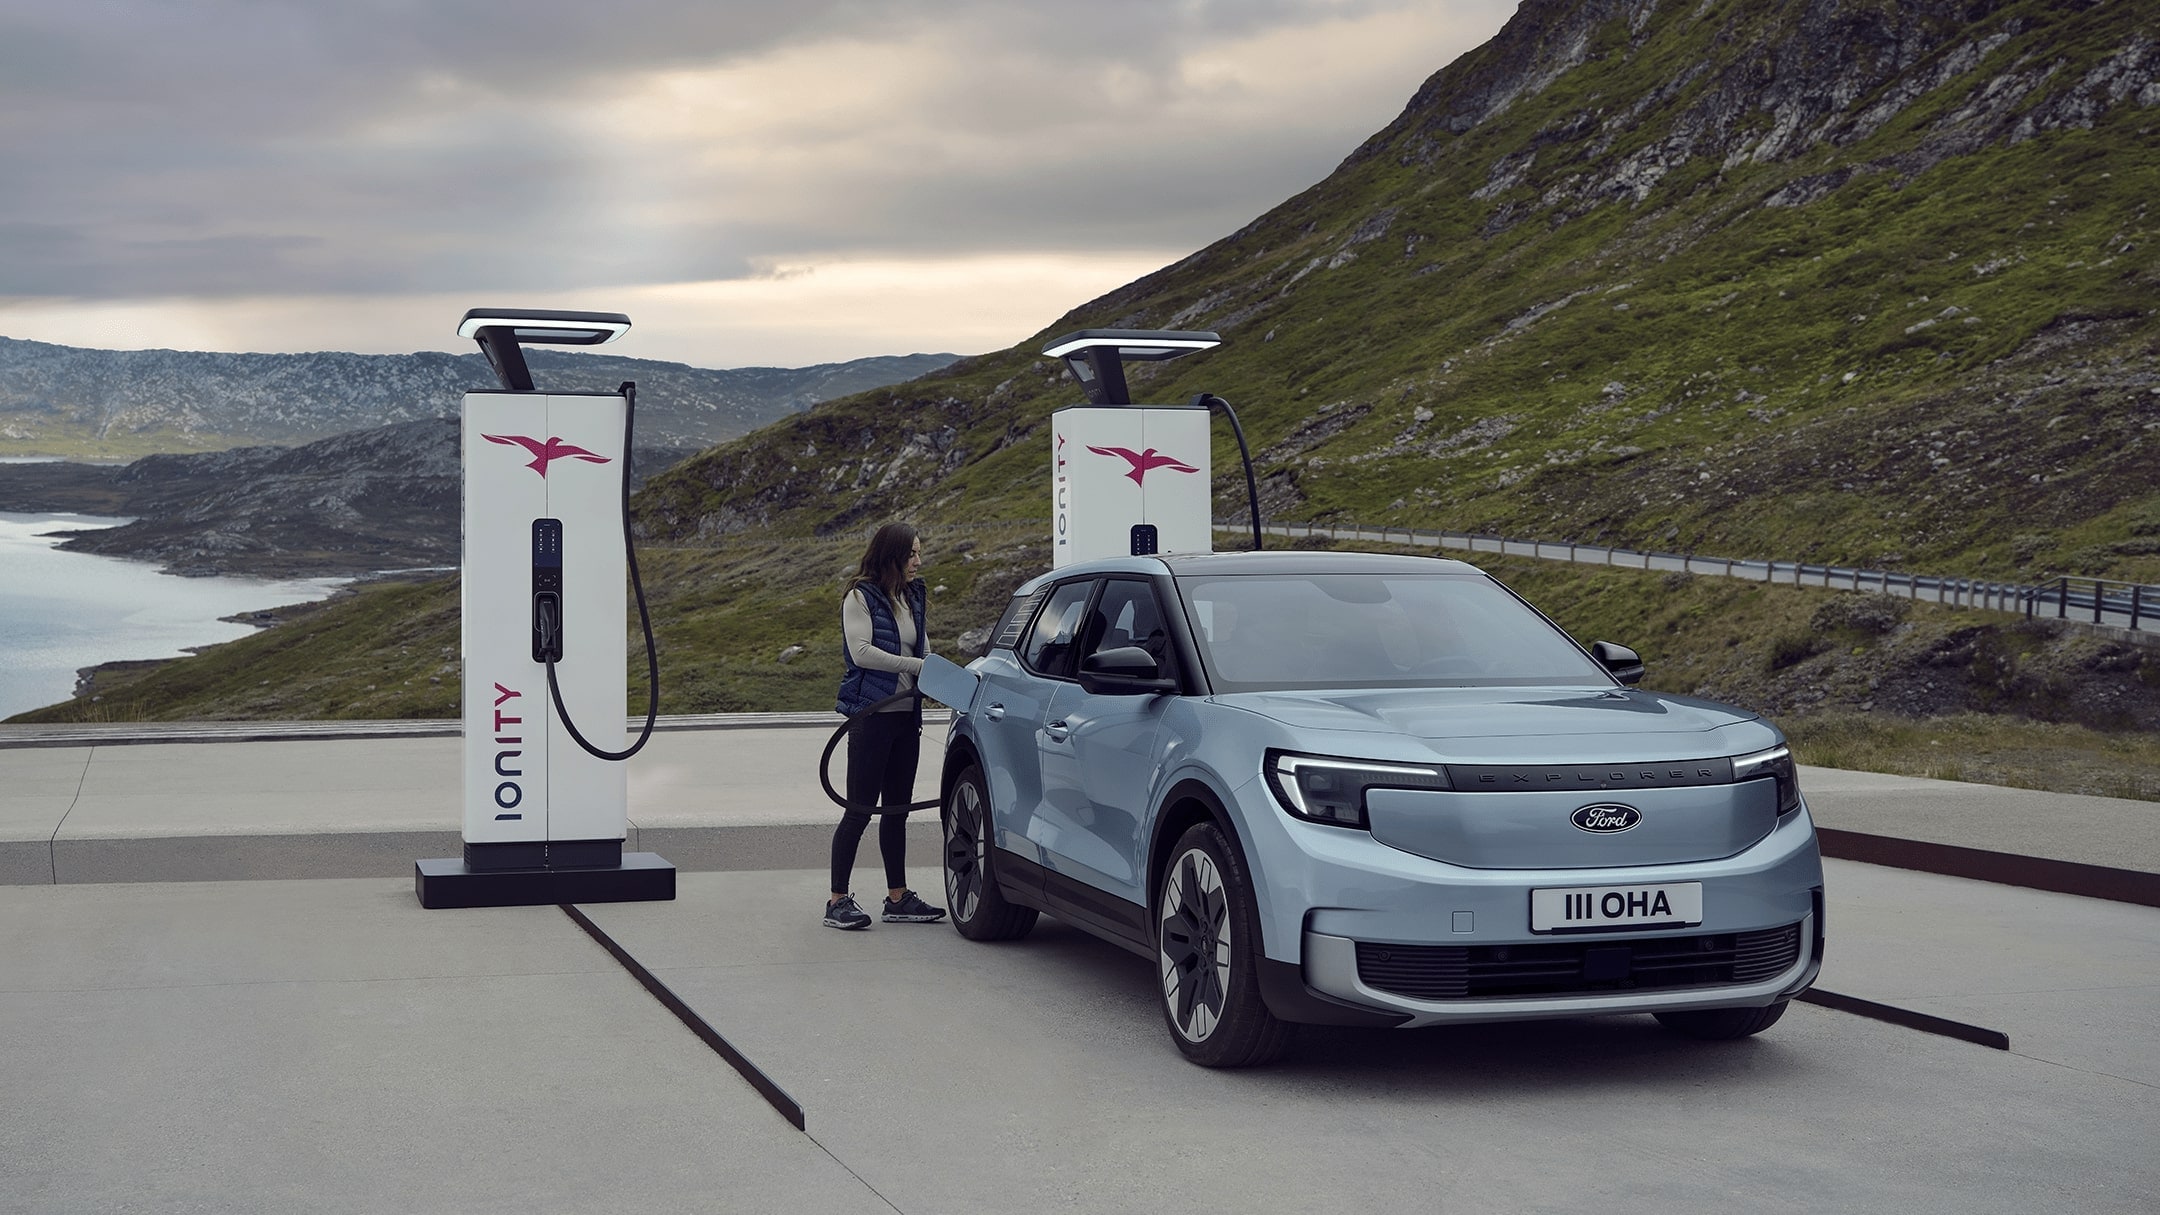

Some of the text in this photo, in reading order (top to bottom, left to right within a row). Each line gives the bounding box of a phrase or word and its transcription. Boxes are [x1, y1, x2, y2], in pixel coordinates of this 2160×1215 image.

[1057, 432, 1066, 546] IONITY
[494, 681, 522, 821] IONITY
[1478, 768, 1713, 783] EXPLORER
[1600, 890, 1672, 919] OHA
